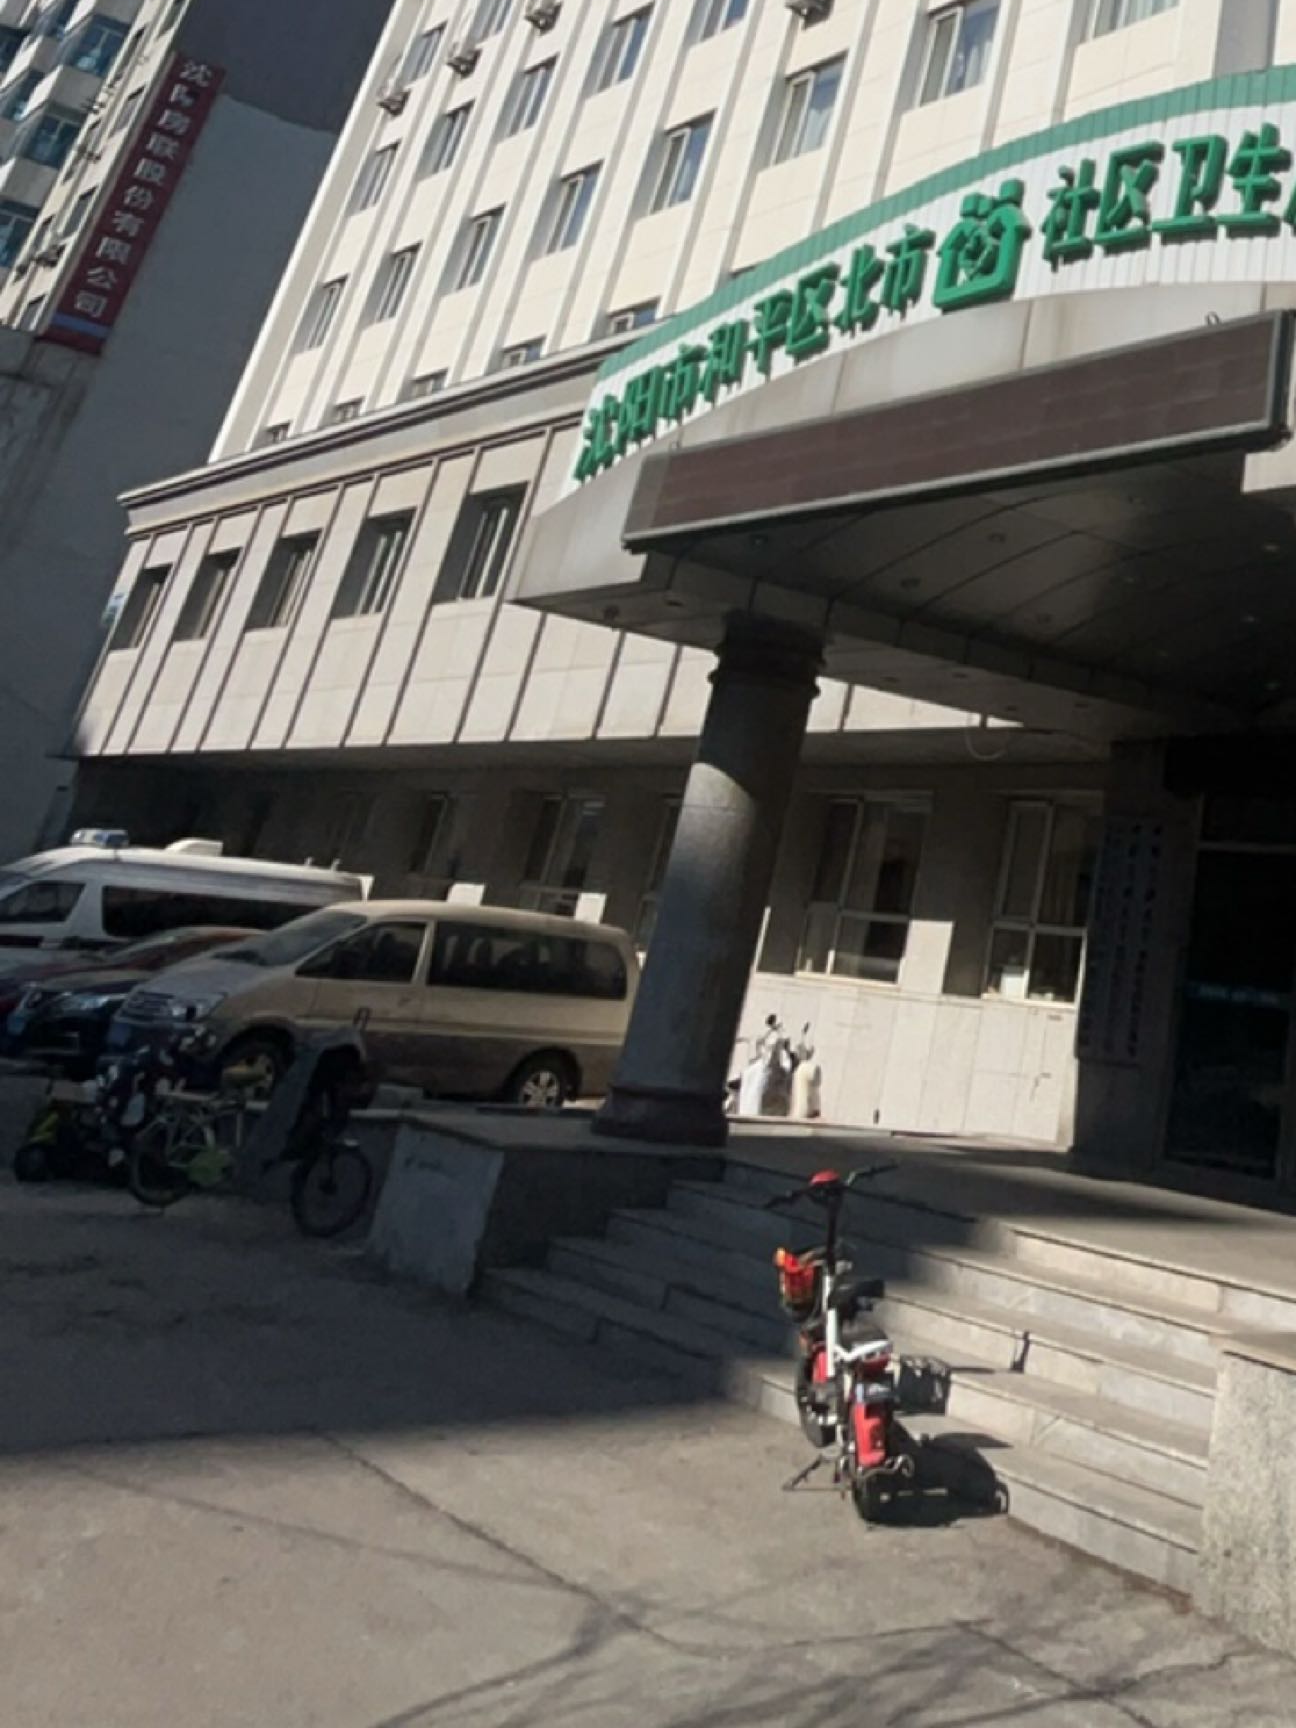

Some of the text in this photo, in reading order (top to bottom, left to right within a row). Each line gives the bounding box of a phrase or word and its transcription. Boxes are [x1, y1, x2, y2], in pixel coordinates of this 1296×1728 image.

[573, 222, 935, 484] 沈阳市和平区北市
